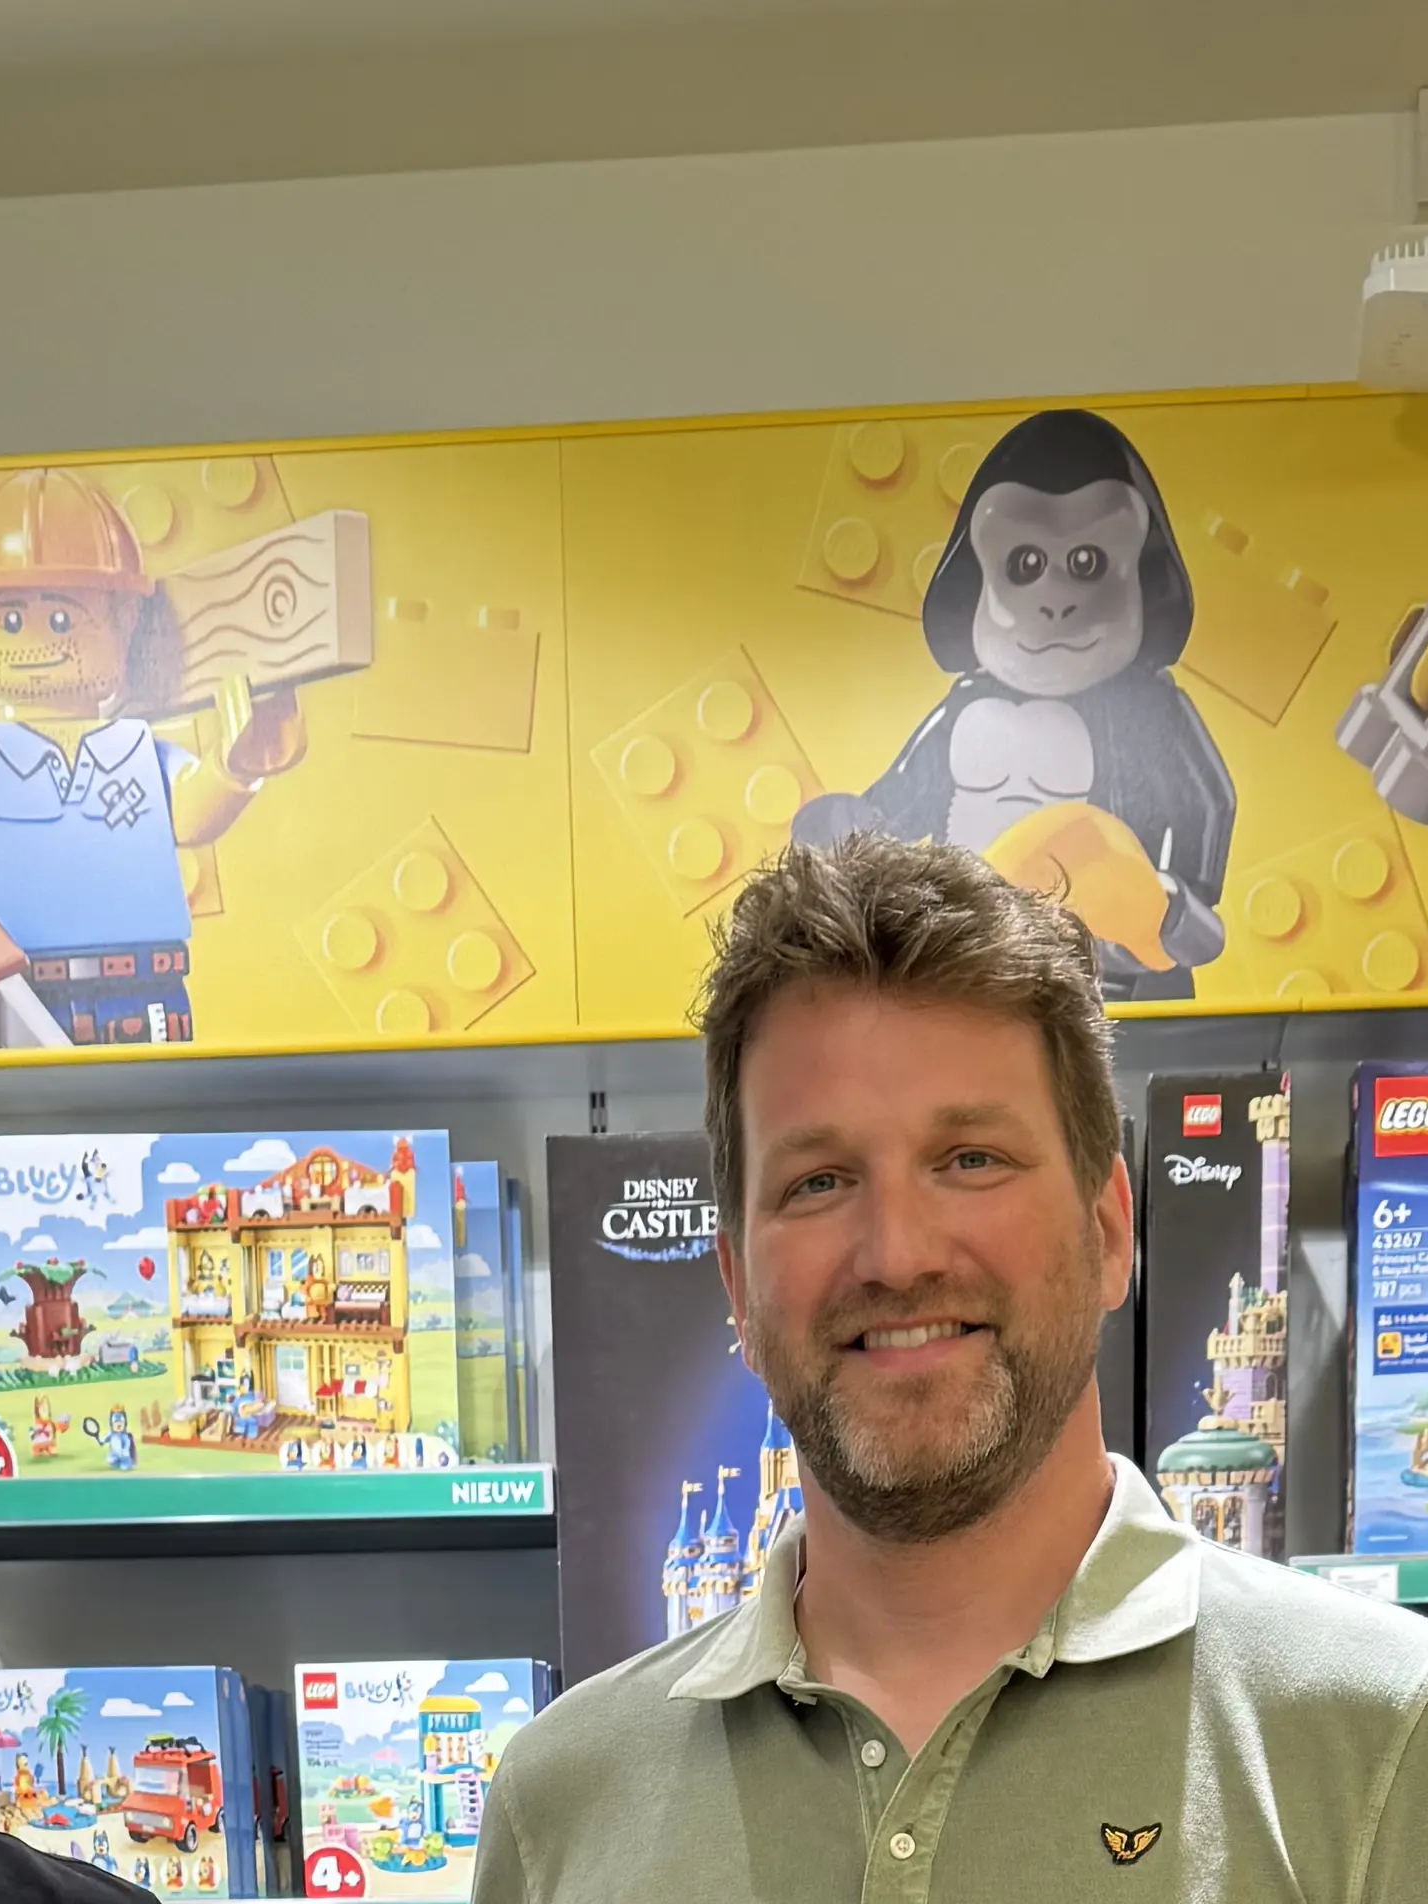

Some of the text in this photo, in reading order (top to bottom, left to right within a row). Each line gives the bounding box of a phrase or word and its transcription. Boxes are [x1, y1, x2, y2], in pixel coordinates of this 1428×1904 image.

[1185, 1105, 1221, 1127] LEGO
[623, 1177, 699, 1201] DISNEY
[602, 1205, 719, 1242] CASTLE
[1373, 1199, 1412, 1229] 6+
[451, 1480, 536, 1506] NIEUW
[310, 1857, 361, 1893] 4+
